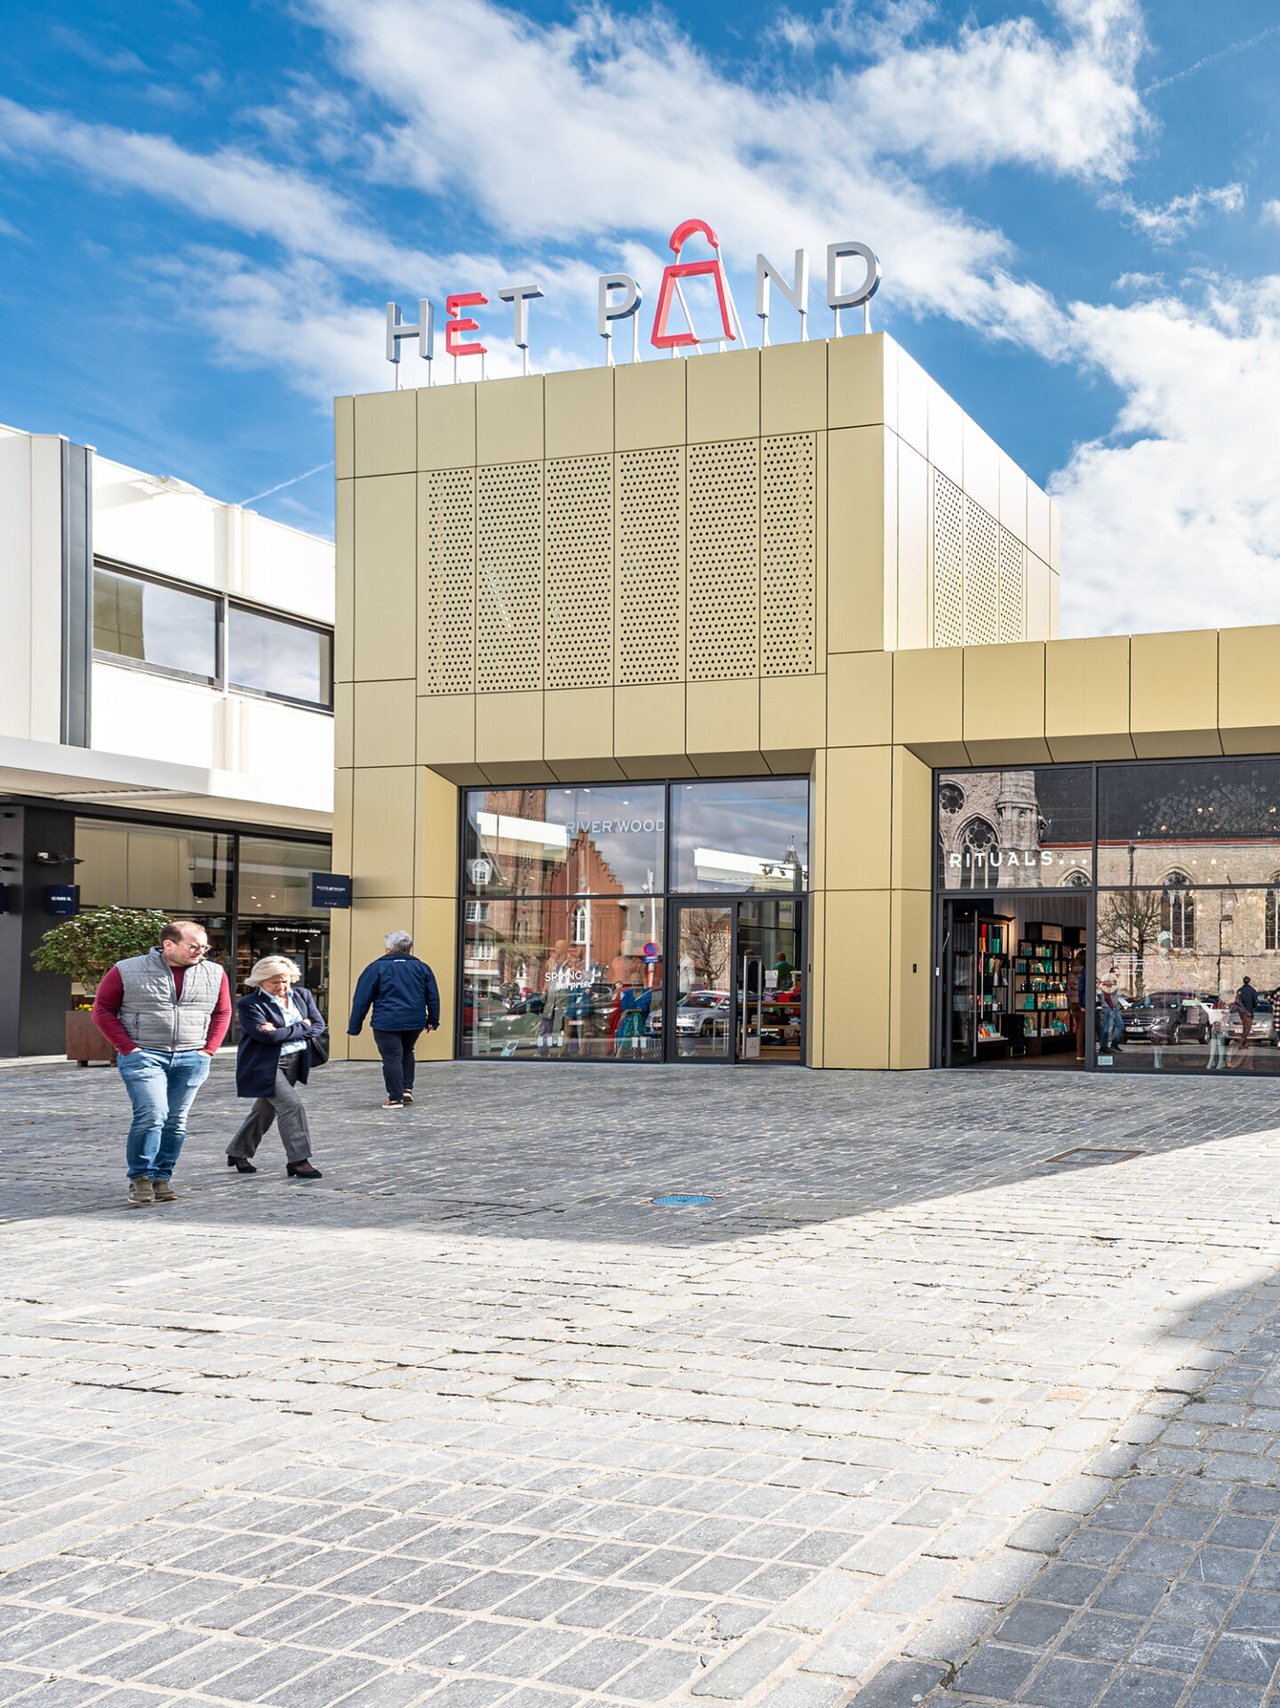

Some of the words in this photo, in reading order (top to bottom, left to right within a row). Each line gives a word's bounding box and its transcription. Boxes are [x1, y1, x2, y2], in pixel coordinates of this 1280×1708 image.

[386, 284, 545, 363] HET
[598, 218, 883, 349] PAND
[566, 820, 613, 833] RIVER
[544, 970, 583, 982] SPNG
